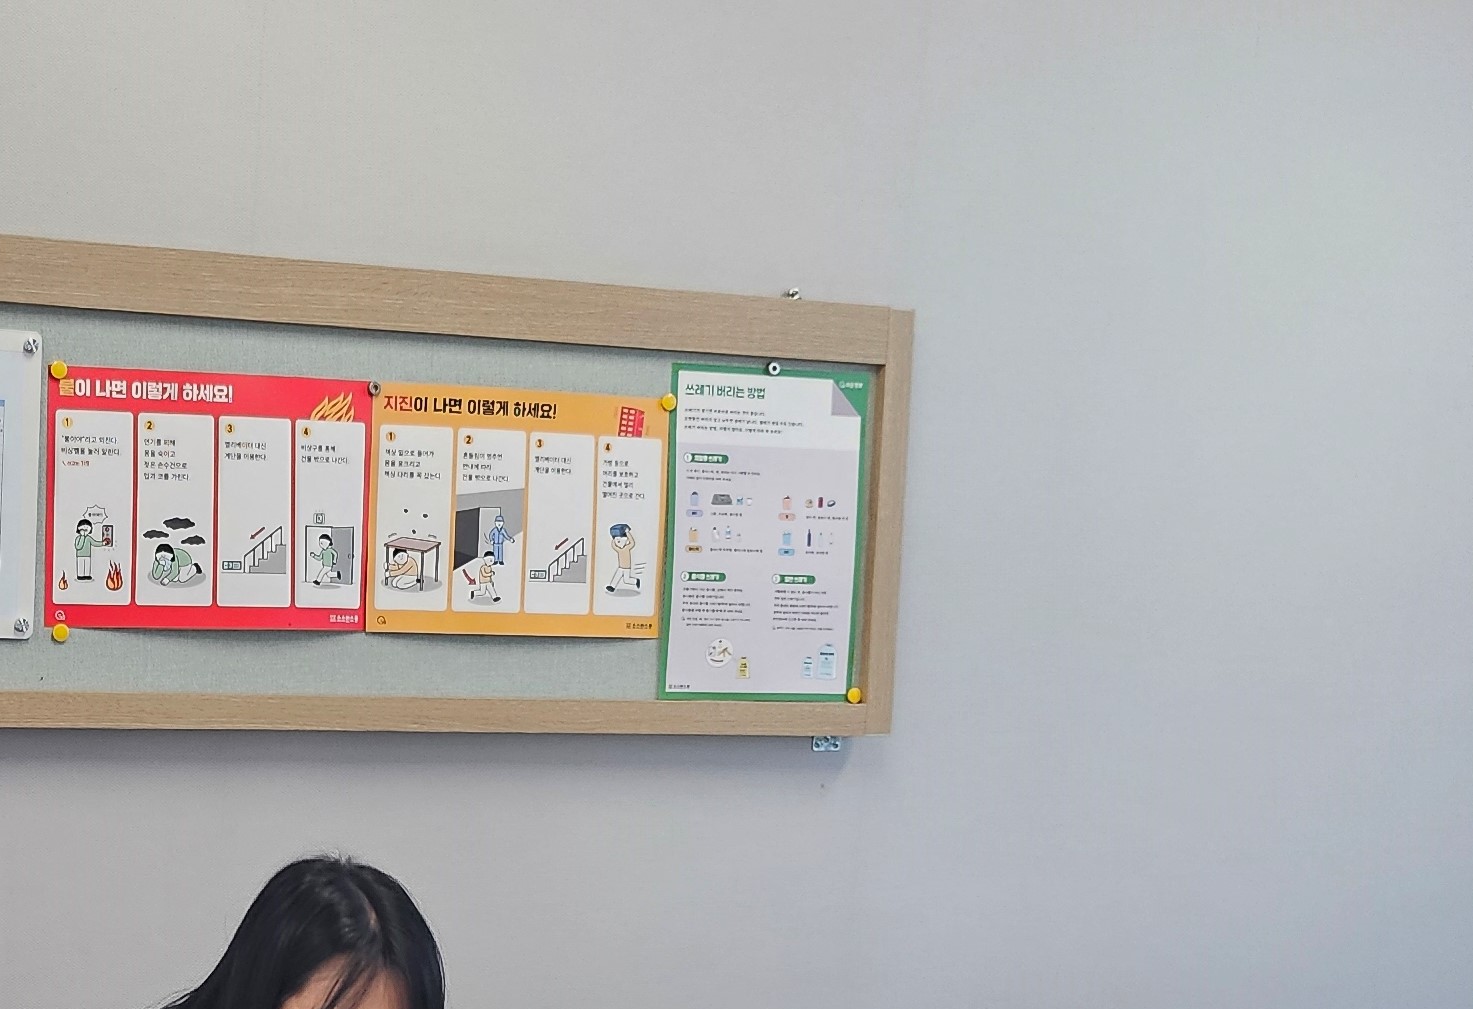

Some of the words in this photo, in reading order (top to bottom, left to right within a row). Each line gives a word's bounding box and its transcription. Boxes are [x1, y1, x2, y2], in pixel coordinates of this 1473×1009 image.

[59, 378, 91, 397] 불이
[95, 379, 127, 399] 나면
[131, 381, 179, 401] 이렇게
[182, 383, 234, 404] 하세요!
[685, 384, 715, 397] 쓰레기
[716, 385, 745, 398] 버리는
[747, 387, 766, 400] 방법
[383, 395, 428, 413] 지진이
[433, 397, 462, 415] 나면
[467, 399, 509, 417] 이렇게
[513, 401, 557, 420] 하세요!
